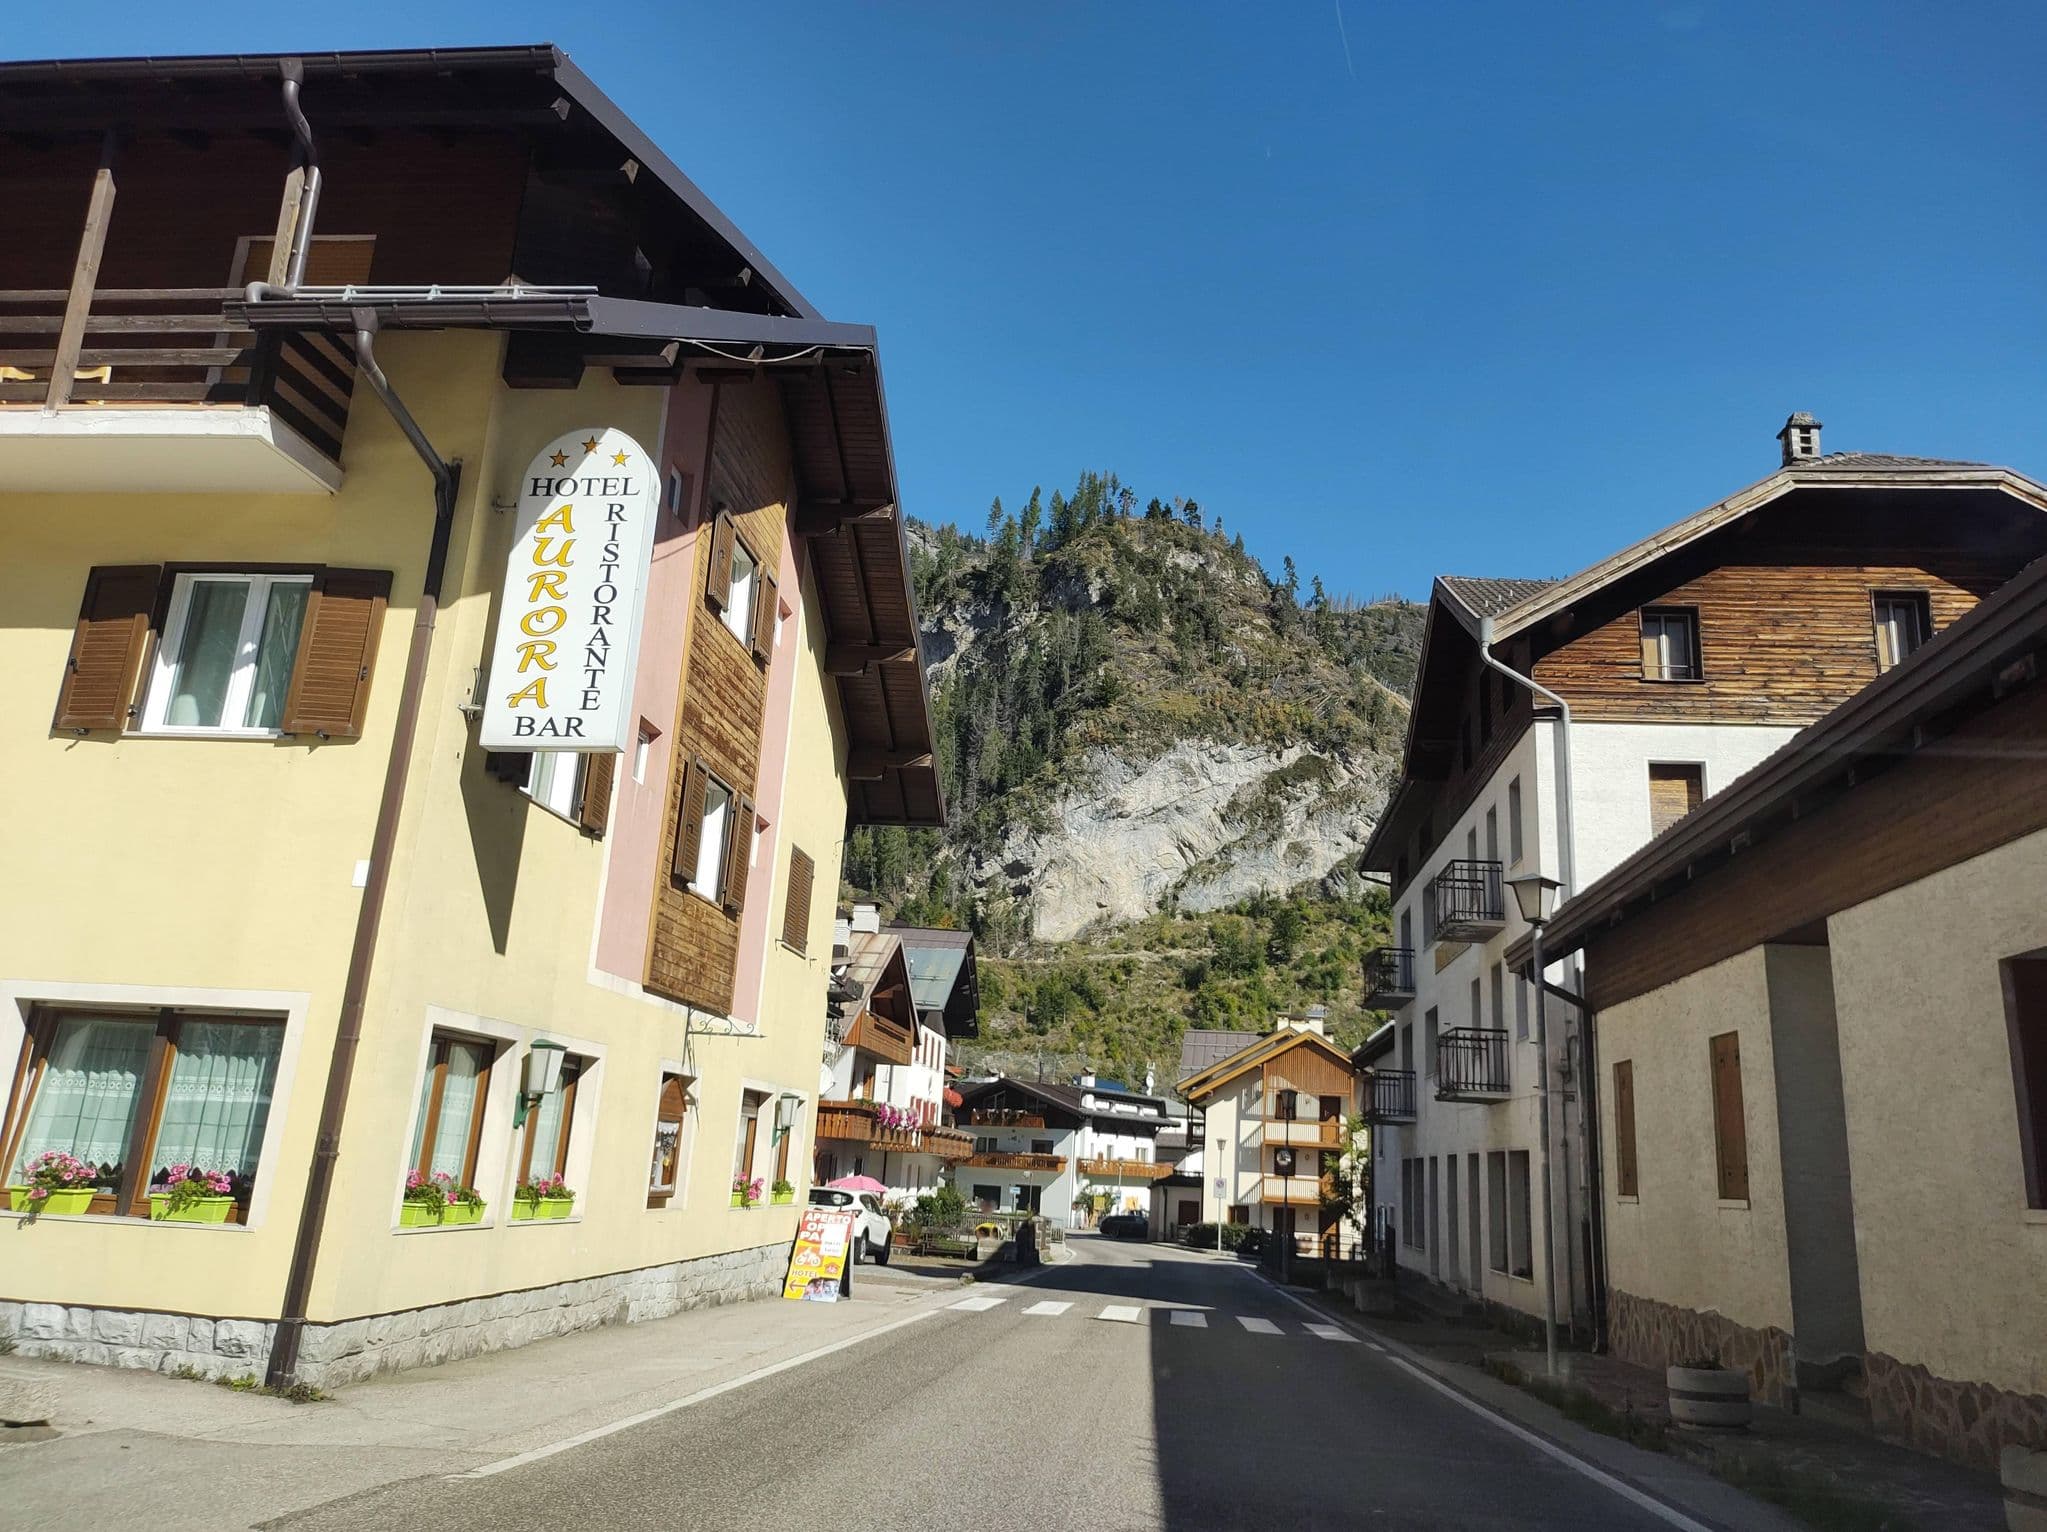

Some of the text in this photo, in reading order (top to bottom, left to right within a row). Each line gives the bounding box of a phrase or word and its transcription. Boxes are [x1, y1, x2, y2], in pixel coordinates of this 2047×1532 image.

[529, 477, 640, 497] HOTEL
[506, 504, 576, 709] AURORA
[579, 503, 628, 711] RISTORANTE
[512, 716, 587, 738] BAR
[805, 1211, 851, 1224] APERTO
[791, 1270, 818, 1278] HOTEL
